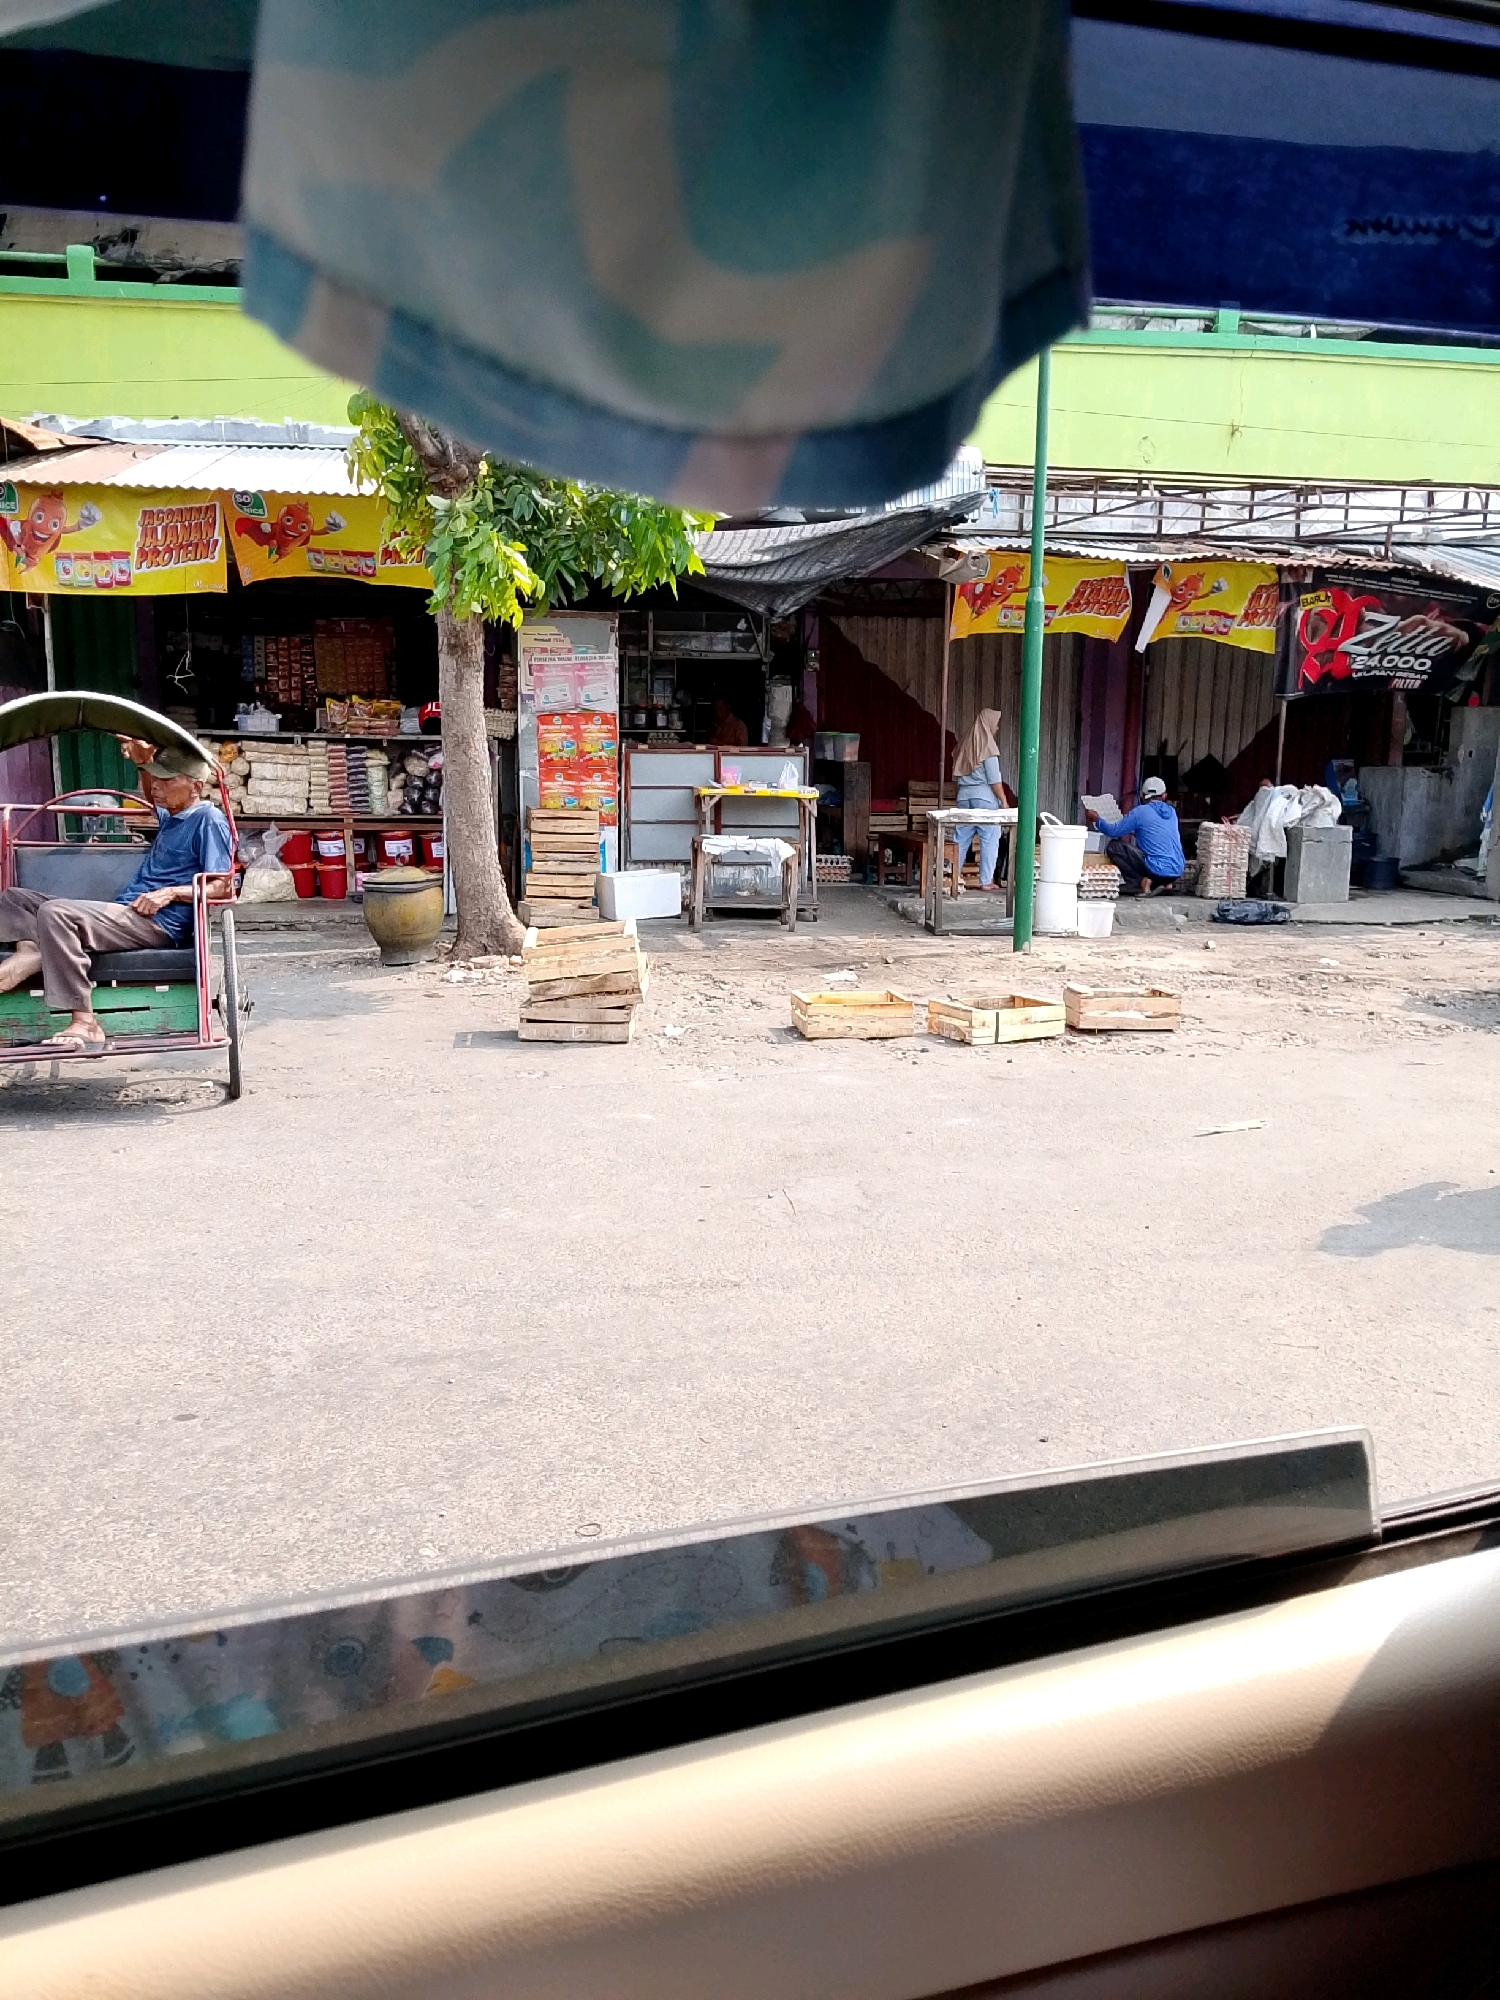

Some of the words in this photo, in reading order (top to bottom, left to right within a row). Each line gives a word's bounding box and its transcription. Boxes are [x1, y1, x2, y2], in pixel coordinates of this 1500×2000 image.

[235, 494, 251, 503] SO
[243, 507, 265, 515] NICE
[136, 519, 217, 548] JAJANAN
[135, 538, 220, 570] PROTEIN!
[1338, 611, 1453, 657] Zetta
[1391, 678, 1422, 688] FILTER
